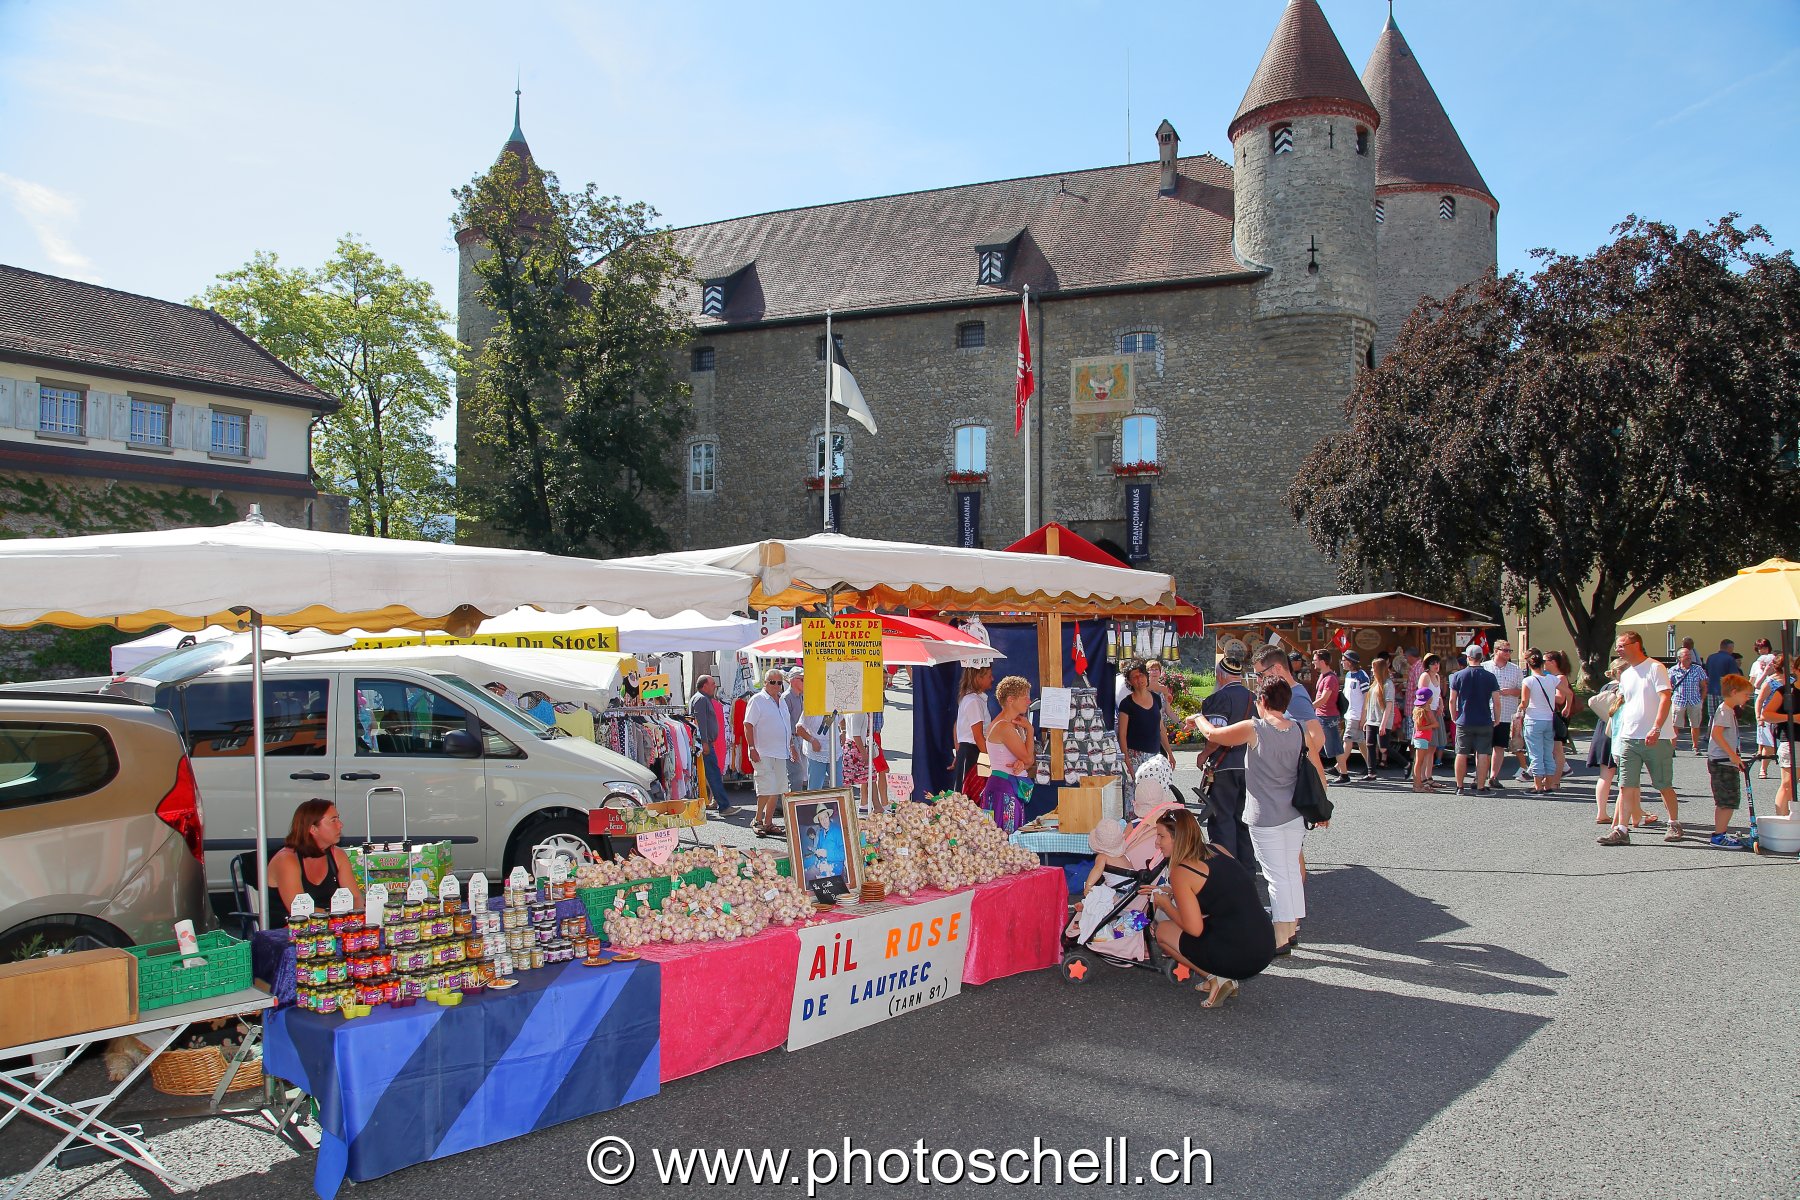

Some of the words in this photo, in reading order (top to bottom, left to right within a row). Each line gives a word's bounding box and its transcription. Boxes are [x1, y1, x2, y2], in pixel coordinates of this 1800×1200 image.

[515, 636, 543, 648] Du
[552, 632, 610, 650] Stock
[821, 631, 870, 639] LAUTREC
[885, 912, 961, 959] ROSE
[802, 994, 829, 1021] DE
[850, 962, 932, 1005] LAUTREC
[888, 992, 922, 1016] (TARN
[929, 977, 948, 1000] 81)
